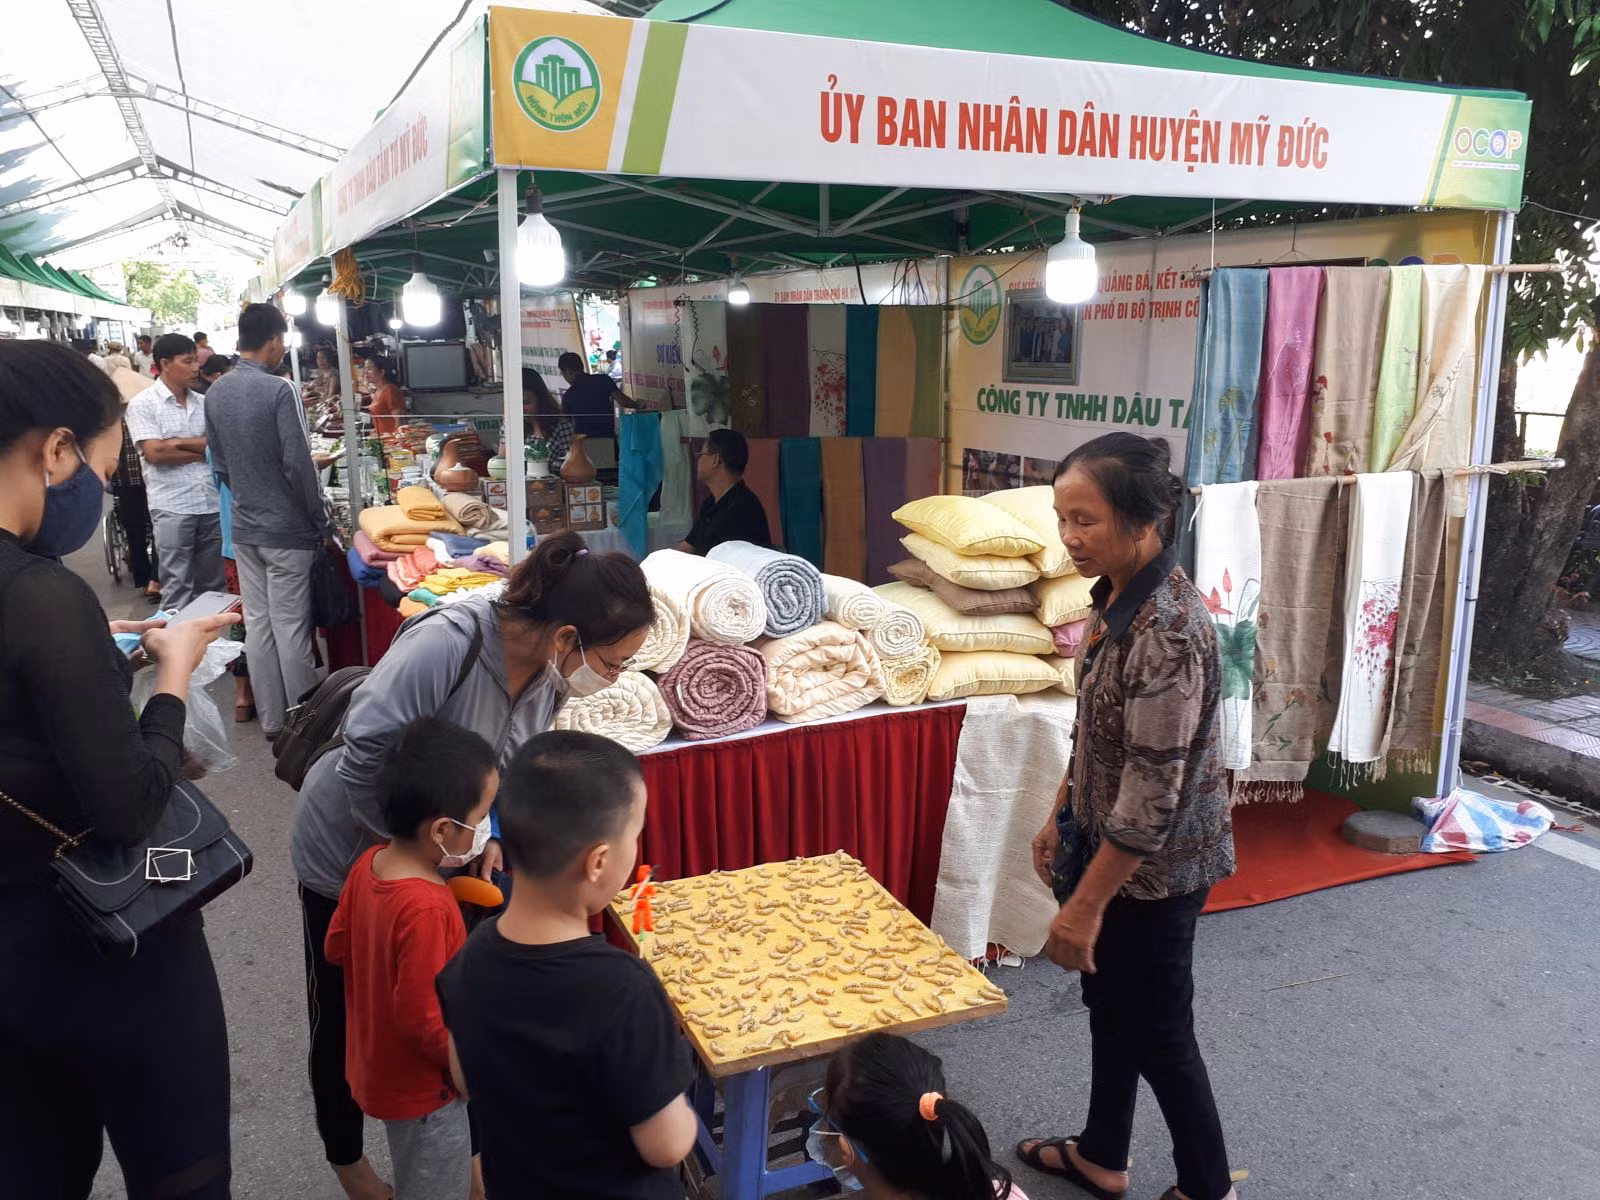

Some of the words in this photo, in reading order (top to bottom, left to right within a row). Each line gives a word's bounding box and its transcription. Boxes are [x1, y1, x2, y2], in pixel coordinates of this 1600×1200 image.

[820, 74, 865, 144] ỦY
[877, 95, 946, 149] BAN
[958, 95, 1048, 154] NHÂN
[1057, 101, 1120, 158] DÂN
[1129, 109, 1221, 173] HUYỆN
[1229, 115, 1271, 166] MỸ
[1277, 117, 1329, 169] ĐỨC
[1454, 127, 1523, 159] OCOP
[1156, 265, 1178, 289] KẾT
[1094, 295, 1115, 320] PHỐ
[1117, 301, 1128, 319] ĐI
[1131, 299, 1145, 323] BỘ
[1150, 300, 1181, 322] TRỊNH
[976, 384, 1021, 415] CÔNG
[1026, 391, 1050, 417] TY
[1055, 393, 1108, 422] TNHH
[1112, 392, 1162, 427] DÂU
